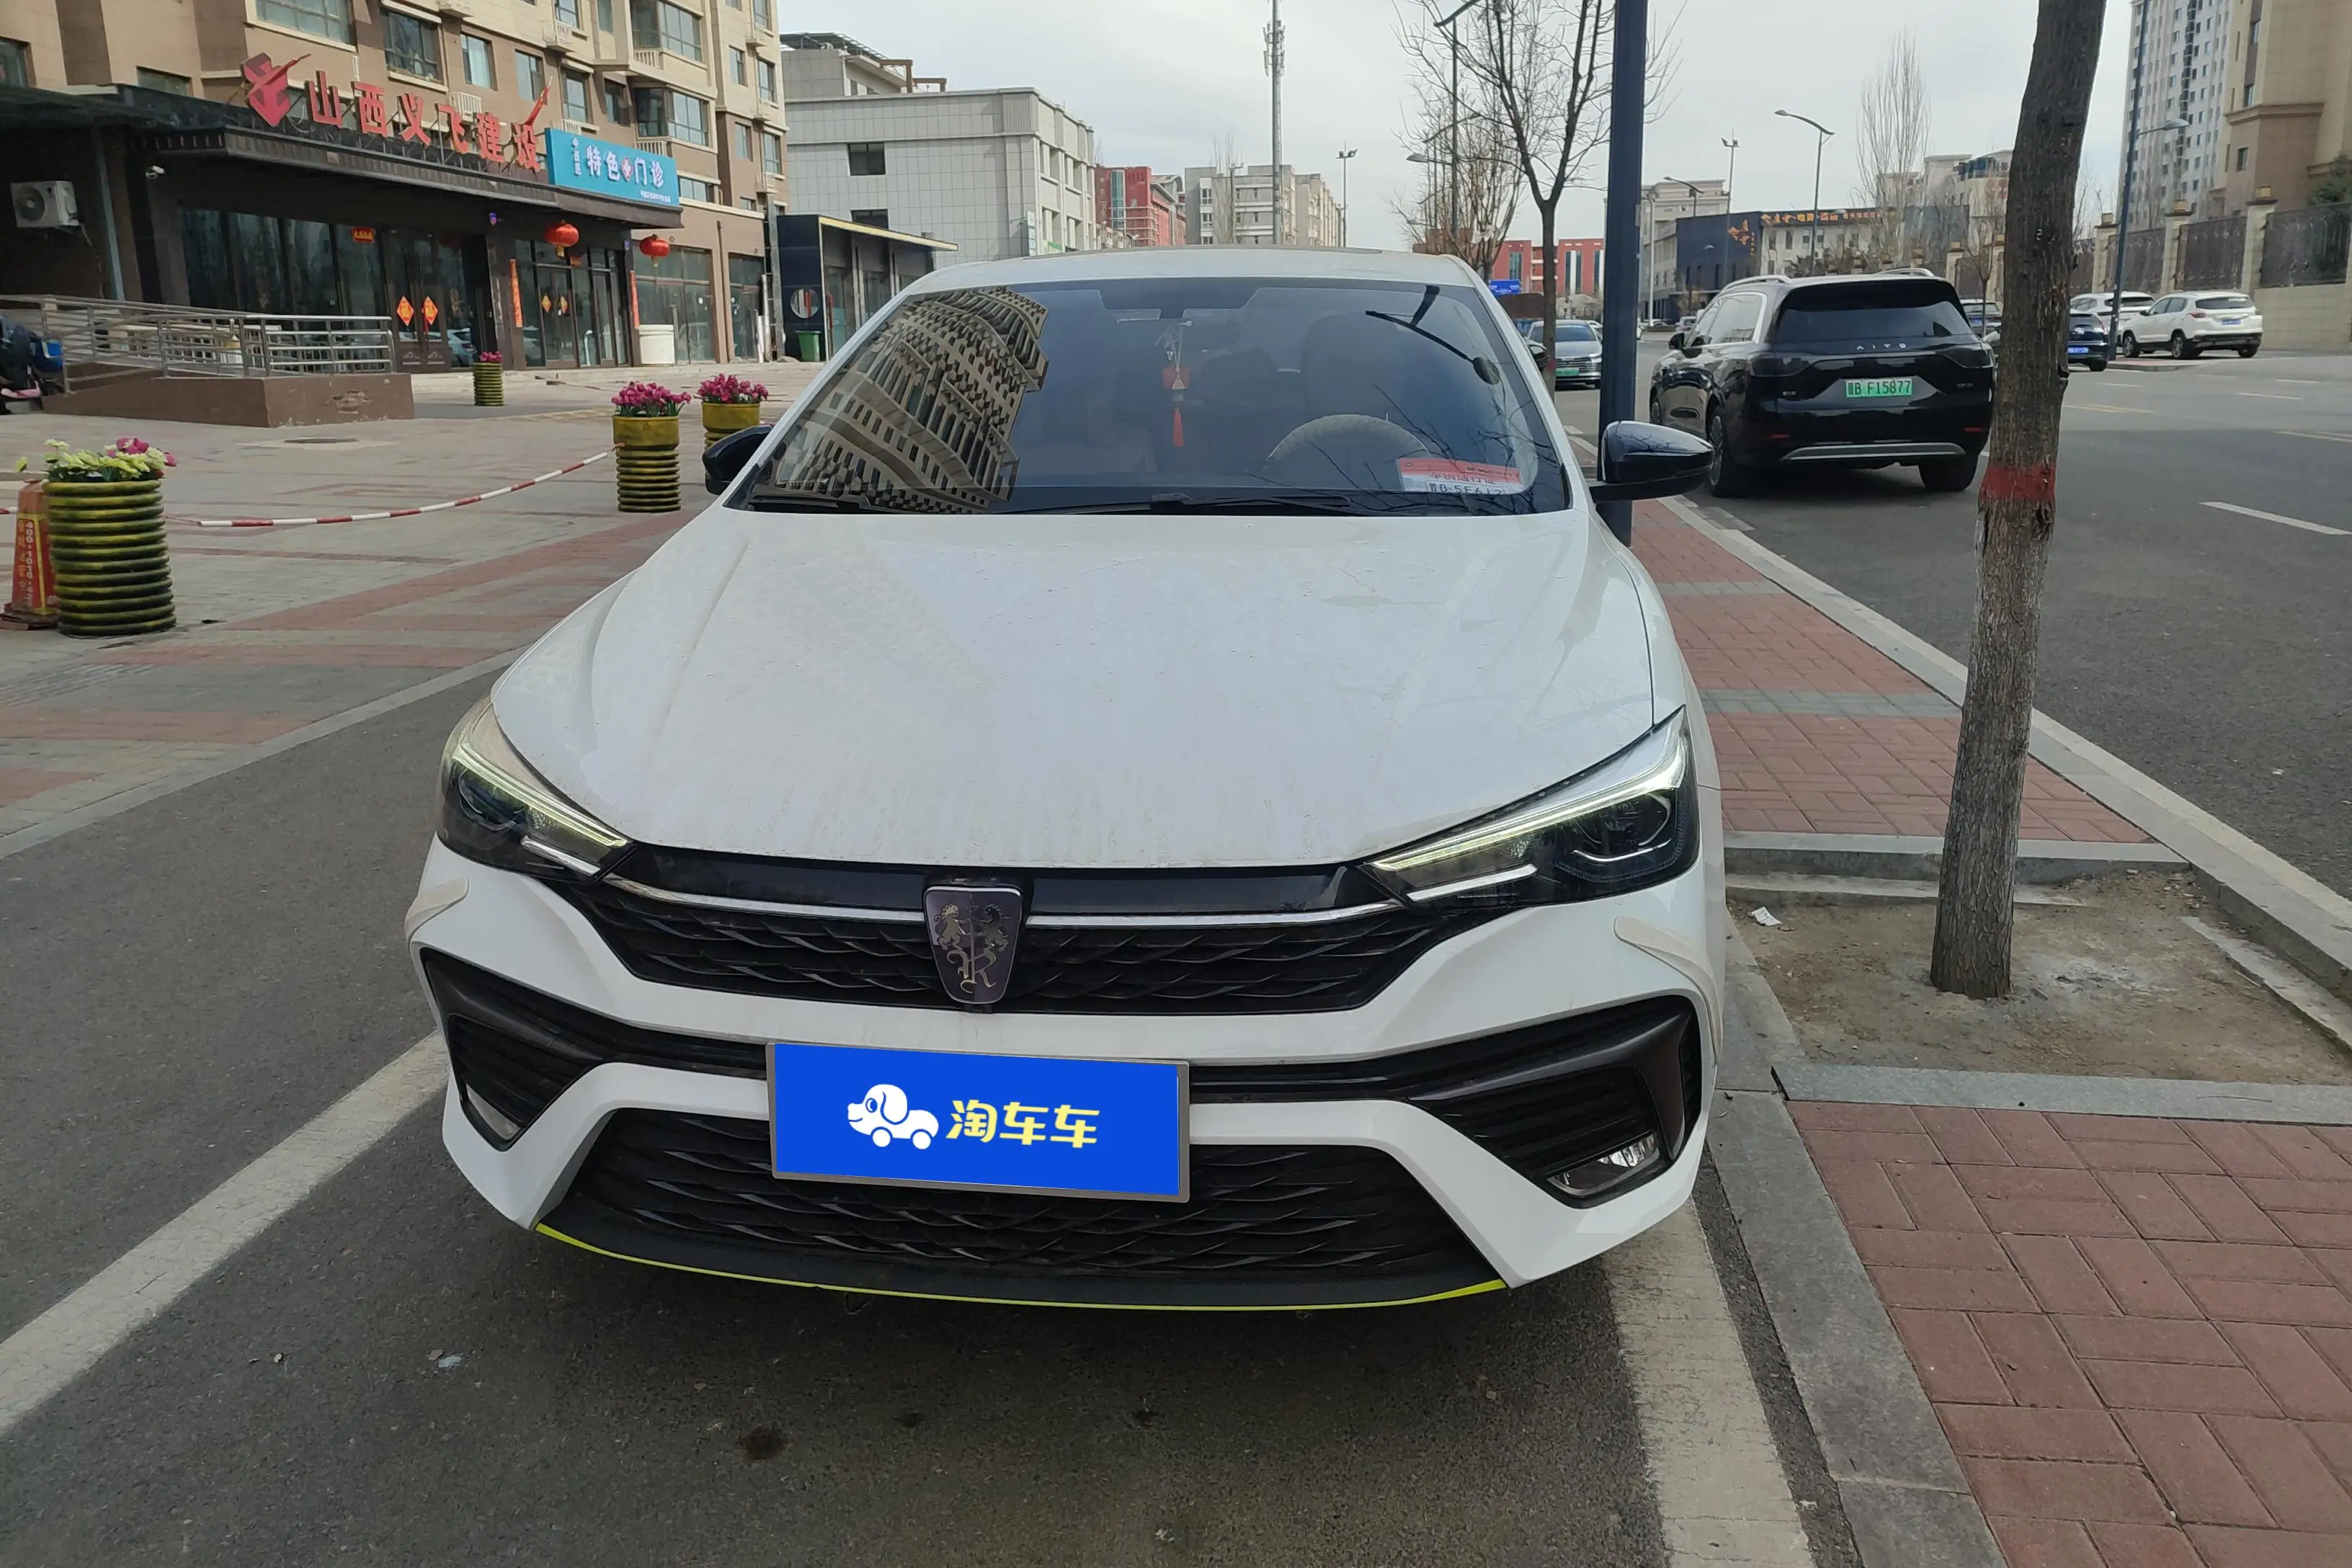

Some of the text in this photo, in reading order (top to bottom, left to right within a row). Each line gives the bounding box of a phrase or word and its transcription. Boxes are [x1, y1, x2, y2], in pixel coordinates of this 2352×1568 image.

[304, 69, 553, 172] 山西义飞建设
[586, 144, 664, 189] 特色门诊
